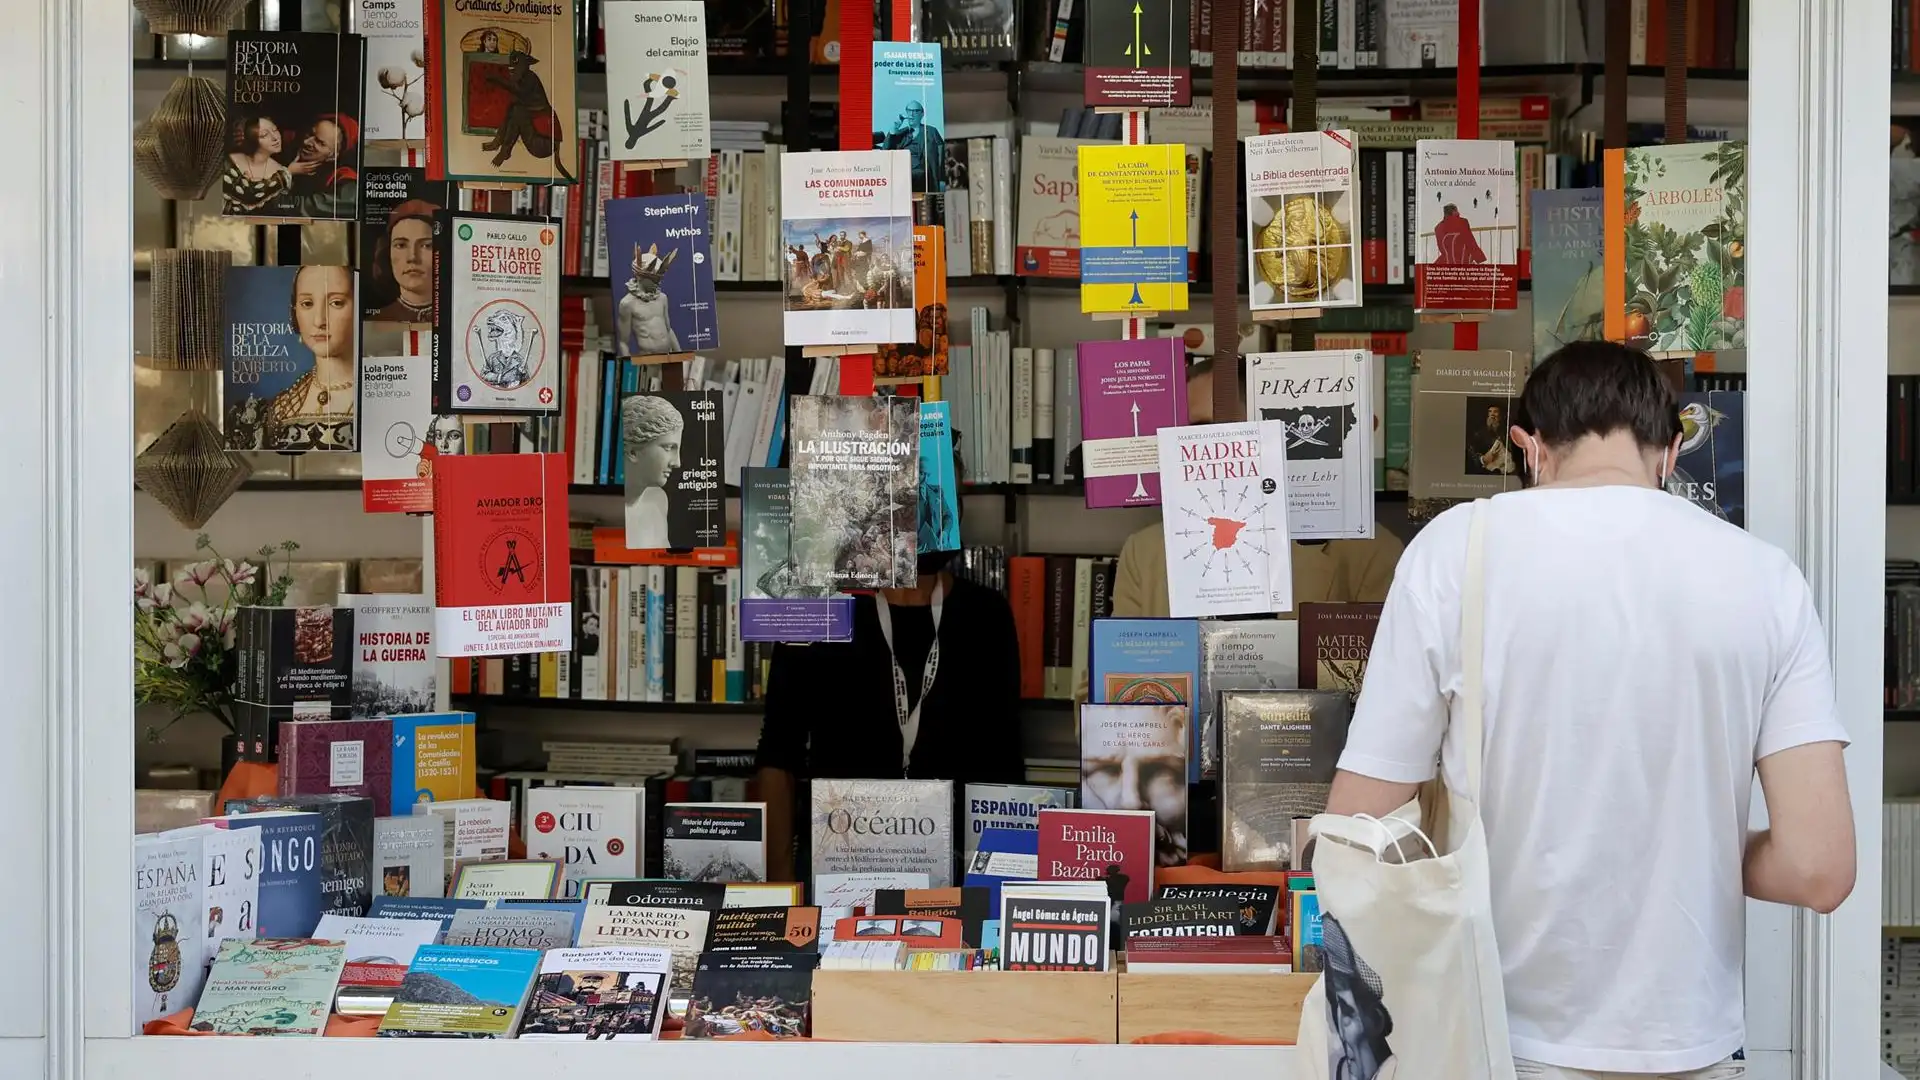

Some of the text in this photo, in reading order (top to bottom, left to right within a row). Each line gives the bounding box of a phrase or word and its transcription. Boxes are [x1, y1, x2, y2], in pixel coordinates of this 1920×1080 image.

[362, 0, 397, 10] Camps
[362, 10, 398, 21] Tiempo
[634, 13, 663, 23] Shane
[376, 19, 419, 29] cuidados
[1272, 7, 1282, 52] VENCER
[235, 41, 298, 55] HISTORIA
[646, 48, 661, 58] del
[235, 64, 301, 77] FEALDAD
[874, 61, 916, 73] poder de las
[234, 81, 301, 94] UMBERTO
[234, 92, 262, 104] ECO
[706, 155, 718, 198] BEEVOR
[1251, 166, 1349, 181] La Biblia desenterrada
[1424, 166, 1515, 176] Antonio Muñoz Molina
[366, 173, 393, 181] Carlos
[1424, 178, 1476, 187] Volver dónde
[366, 181, 407, 190] Pico della
[804, 178, 888, 189] LAS COMUNIDADES
[366, 189, 408, 199] Mirandola
[818, 188, 874, 199] DE CASTILLA
[1646, 187, 1724, 207] ÁRBOLES
[644, 204, 699, 219] Stephen Fry
[486, 232, 528, 241] PABLO GALLO
[665, 227, 702, 240] Mythos
[471, 244, 542, 261] BESTIARIO
[472, 259, 542, 276] DEL NORTE
[232, 323, 294, 336] HISTORIA
[232, 345, 289, 357] BELLEZA
[364, 364, 404, 373] Lola Pons
[1436, 369, 1471, 377] DIARIO DE
[232, 372, 260, 384] ECO
[364, 371, 408, 382] Rodríguez
[1259, 376, 1355, 399] PIRATAS
[691, 400, 715, 410] Edith
[697, 412, 715, 421] Hall
[820, 429, 889, 442] Anthony Pagden
[798, 439, 911, 456] LA ILUSTRACIÓN
[1180, 439, 1260, 463] MADRE
[700, 457, 717, 467] Los
[850, 455, 867, 463] SIGUE
[808, 462, 866, 471] IMPORTANTE PARA
[1183, 460, 1260, 482] PATRIA
[682, 469, 717, 480] griegos
[1312, 470, 1339, 482] Lehr
[678, 480, 717, 491] antiguos
[477, 496, 544, 508] AVIADOR DRO
[825, 571, 880, 580] Alianza Editorial
[1094, 573, 1106, 614] KUKSO
[361, 606, 431, 615] GEOFFREY PARKER
[462, 606, 563, 621] EL GRAN LIBRO MUTANTE
[478, 618, 549, 633] DEL AVIADOR DRO
[359, 632, 430, 646] HISTORIA DE
[487, 633, 507, 641] ESPECIAL
[1239, 632, 1276, 641] Monmany
[1317, 634, 1368, 648] MATER
[490, 639, 533, 652] LA REVOLUCIÓN
[1221, 642, 1254, 653] tiempo
[363, 648, 426, 662] LA GUERRA
[1237, 651, 1264, 661] adiós
[298, 667, 336, 675] Mediterráneo
[289, 674, 348, 684] mundo mediterráneo
[295, 683, 314, 693] época
[1260, 710, 1312, 721] comedia
[427, 731, 460, 740] revolución
[427, 741, 438, 749] las
[417, 749, 462, 760] Comunidades
[427, 759, 451, 768] Castilla
[467, 818, 492, 827] rebelión
[559, 812, 603, 832] CIU
[682, 818, 745, 829] Historia pensamiento
[828, 808, 936, 837] Océano
[474, 826, 504, 836] catalanes
[689, 826, 718, 836] político del
[1061, 825, 1116, 845] Emilia
[564, 845, 597, 866] DA
[849, 845, 927, 855] historia conectividad
[1075, 843, 1125, 863] Pardo
[851, 854, 894, 864] Mediterráneo
[136, 861, 197, 890] ESPAÑA
[1051, 860, 1101, 880] Bazán
[465, 881, 494, 889] Jean
[464, 887, 526, 897] Delumeau
[1159, 886, 1269, 904] Estrategia
[626, 894, 705, 906] Odorama
[379, 909, 419, 919] Imperio,
[1154, 903, 1209, 916] SIR BASIL
[656, 912, 687, 925] ROJA
[717, 910, 785, 922] Inteligencia
[1012, 908, 1099, 923] Ángel Gómez de Ágreda
[1128, 910, 1236, 927] LIDDELL HART
[629, 918, 680, 931] SANGRE
[716, 921, 757, 932] militar
[475, 926, 545, 938] HOMO
[597, 925, 690, 940] LEPANTO
[789, 925, 813, 939] 50
[460, 937, 553, 948] BELLICUS
[1009, 931, 1099, 966] MUNDO
[561, 951, 601, 959] Barbara
[418, 956, 499, 966] LOS AMNÉSICOS
[625, 957, 661, 966] orgullo
[249, 985, 287, 993] NEGRO
